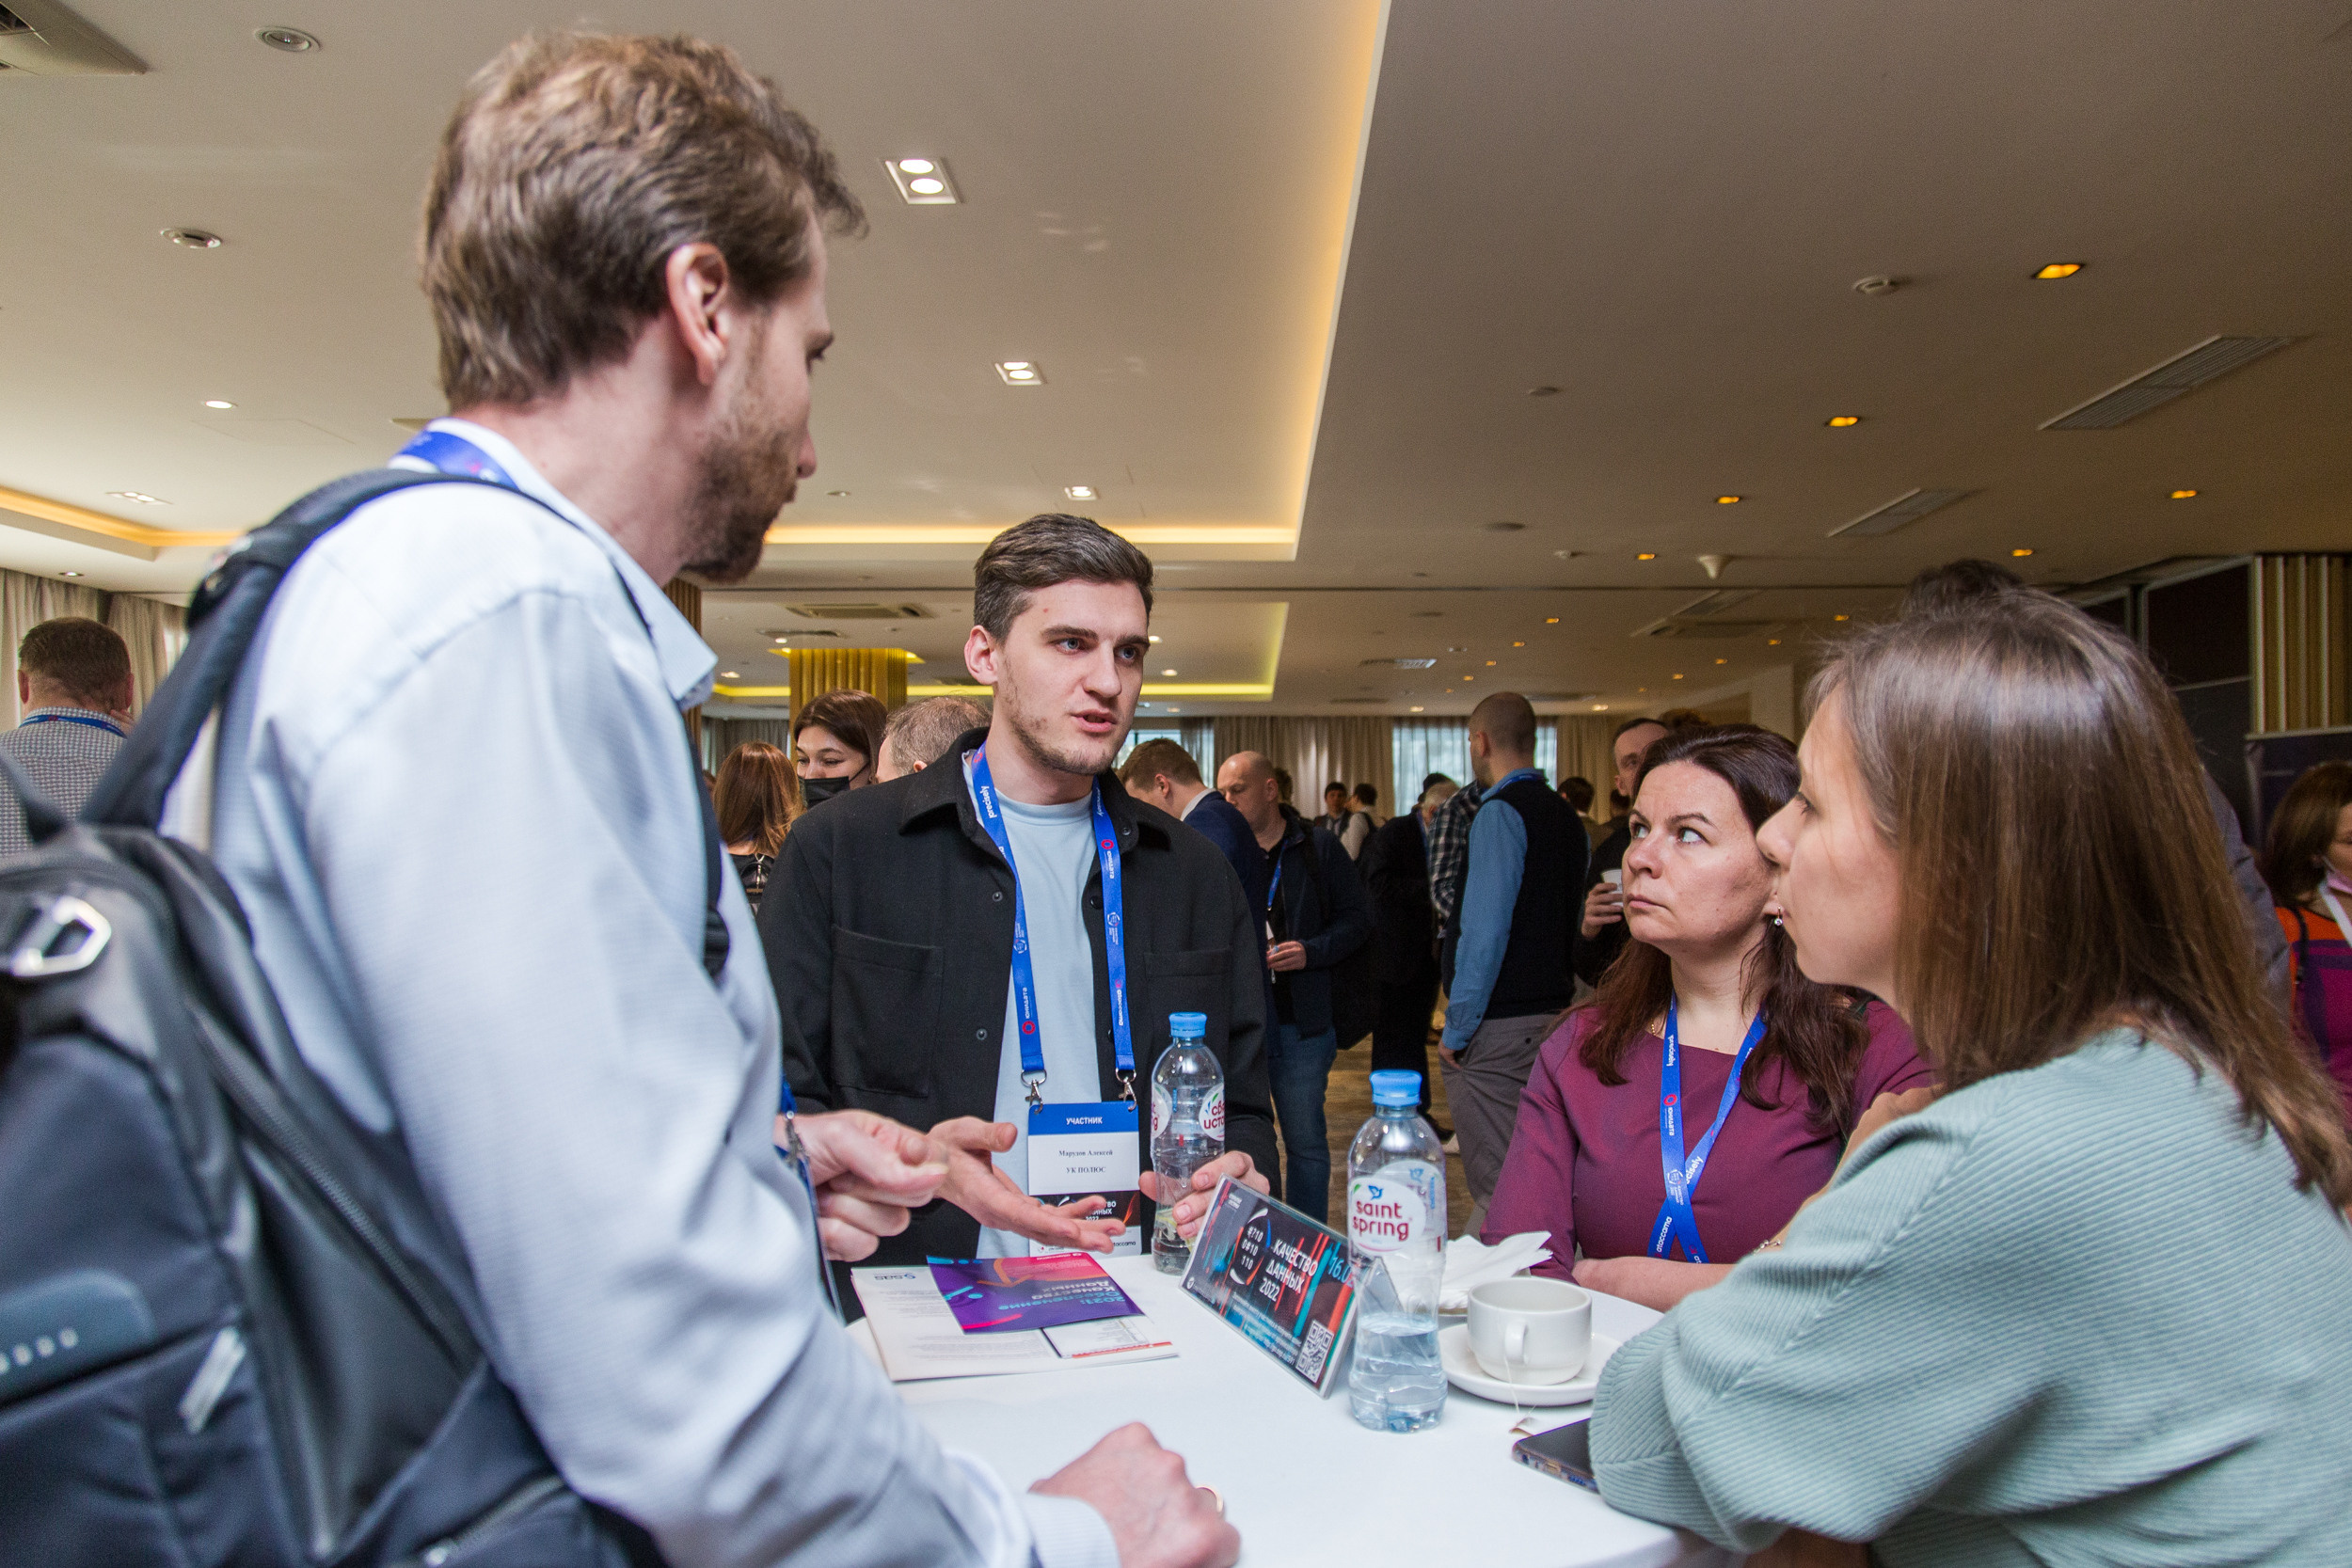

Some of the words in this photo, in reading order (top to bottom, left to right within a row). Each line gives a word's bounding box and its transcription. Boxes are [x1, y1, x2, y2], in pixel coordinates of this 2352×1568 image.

[979, 785, 997, 819] precisely
[1666, 1034, 1677, 1067] precisely
[1065, 1117, 1104, 1125] УЧАСТНИК
[1685, 1155, 1705, 1185] cisely
[1356, 1200, 1403, 1219] saint
[1353, 1216, 1409, 1242] spring
[1656, 1215, 1673, 1254] ataccama
[1241, 1255, 1254, 1271] 110
[1272, 1239, 1318, 1276] КАЧЕСТВО
[1259, 1276, 1280, 1302] 2022
[1265, 1259, 1305, 1294] ДАННЫХ
[998, 1291, 1120, 1310] Обеспечение
[1031, 1286, 1116, 1300] Качества
[1079, 1295, 1126, 1305] 2021:
